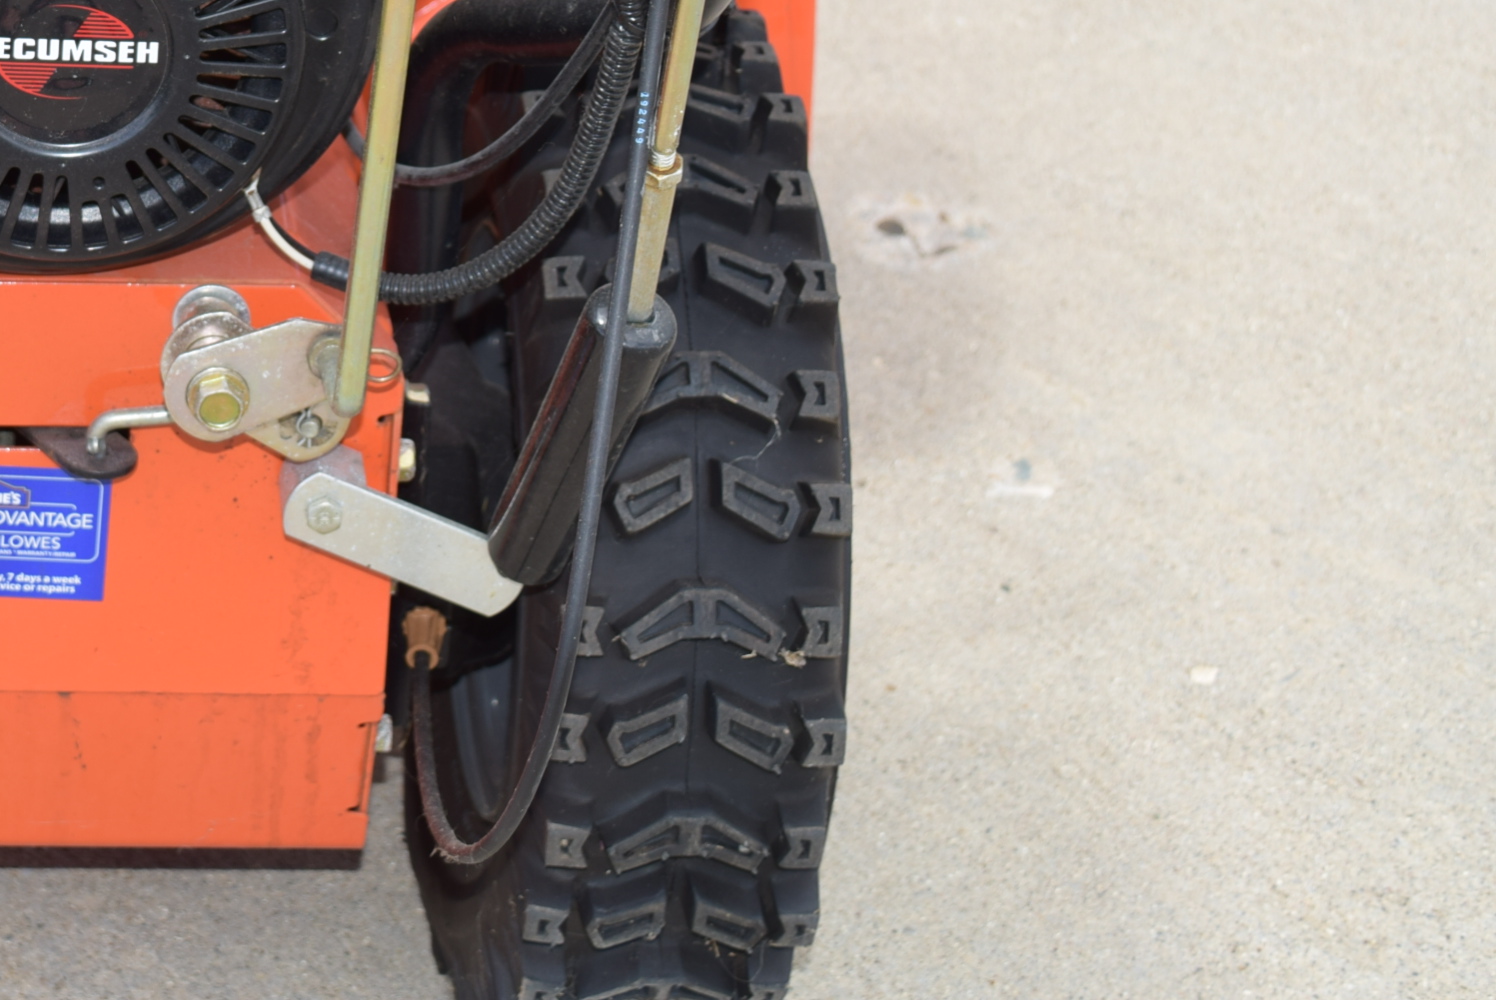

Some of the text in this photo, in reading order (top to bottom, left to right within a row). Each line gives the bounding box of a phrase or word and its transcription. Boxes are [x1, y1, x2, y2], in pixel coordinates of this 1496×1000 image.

[635, 92, 650, 144] 192449
[6, 572, 15, 581] 7
[16, 573, 41, 584] days
[43, 575, 51, 584] a
[52, 574, 82, 585] week
[23, 583, 36, 593] or
[36, 583, 76, 595] repairs
